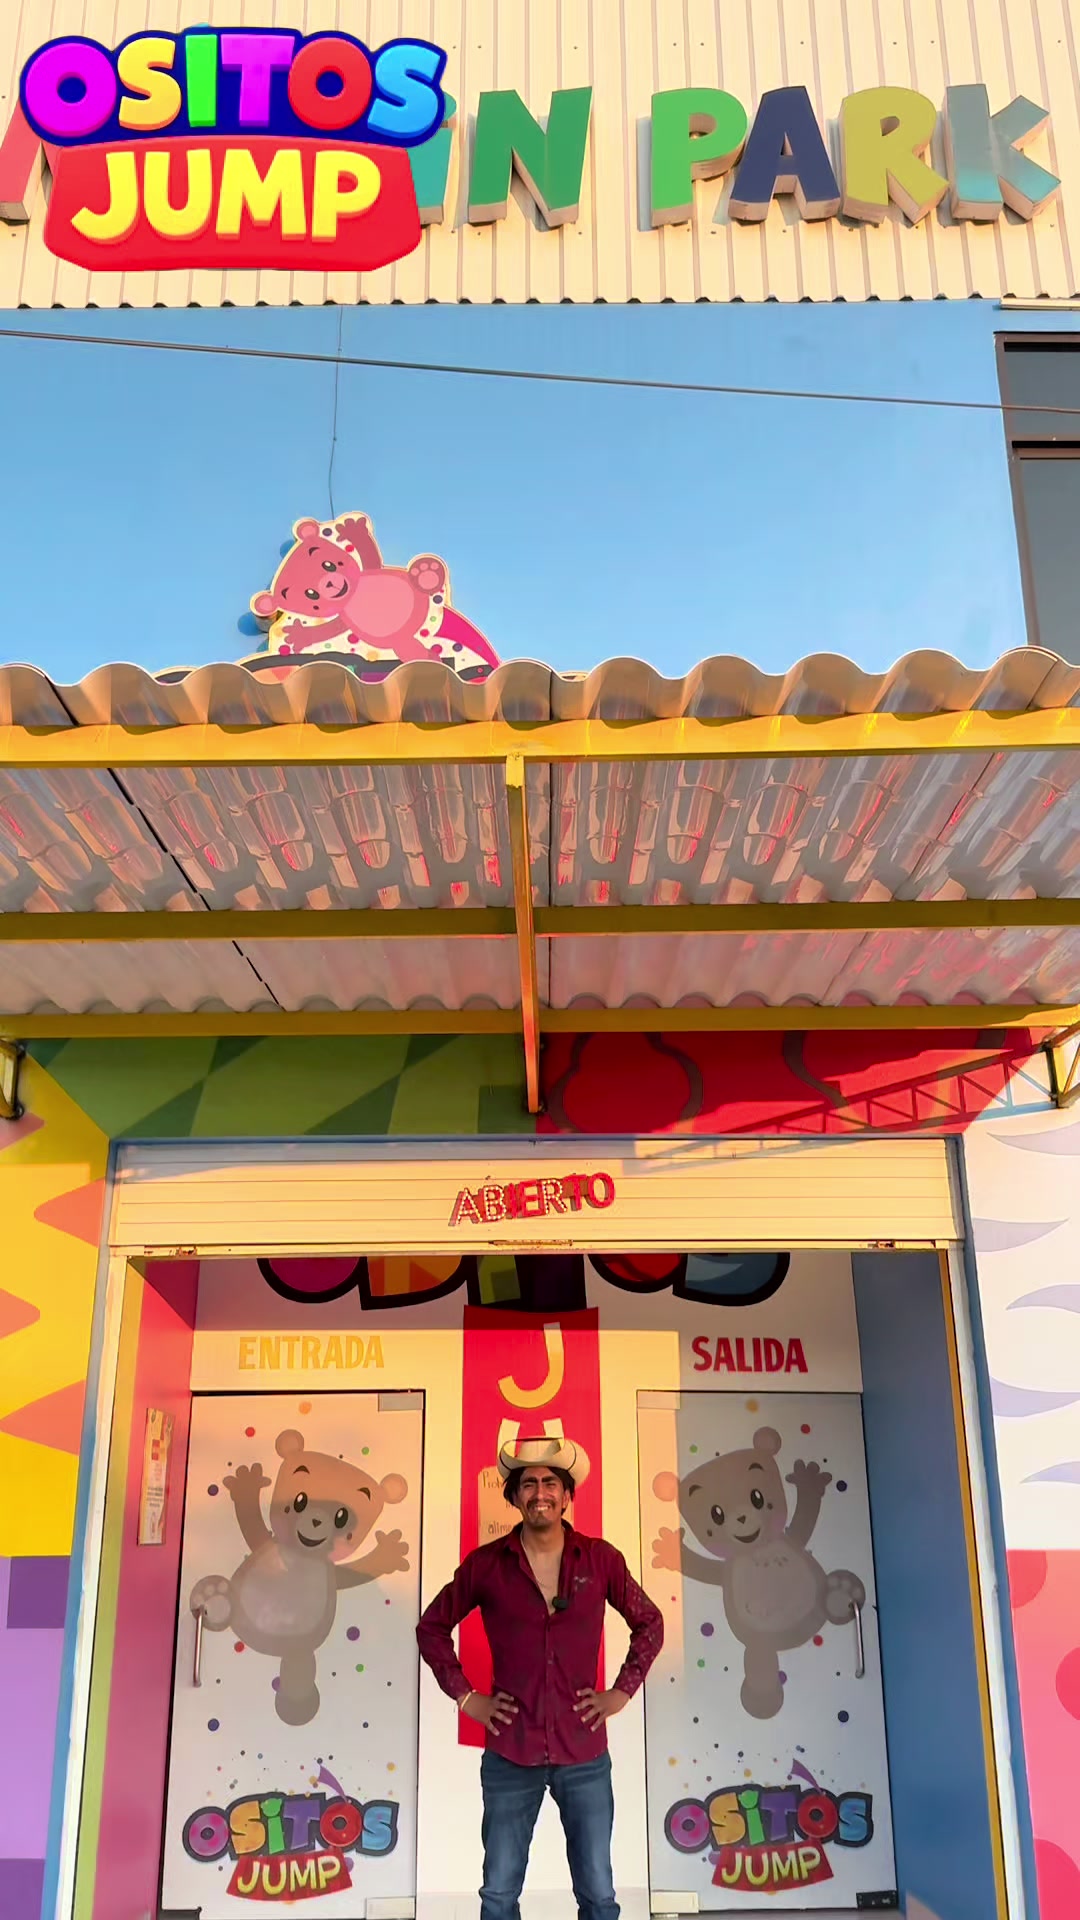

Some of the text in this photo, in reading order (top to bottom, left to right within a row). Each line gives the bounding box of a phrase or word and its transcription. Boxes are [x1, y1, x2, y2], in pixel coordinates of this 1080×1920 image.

[651, 83, 1062, 224] PARK
[448, 1172, 616, 1226] ABIERTO
[238, 1335, 385, 1371] ENTRADA
[691, 1335, 809, 1373] SALIDA
[237, 1855, 341, 1895] JUMP
[720, 1846, 821, 1886] JUMP
